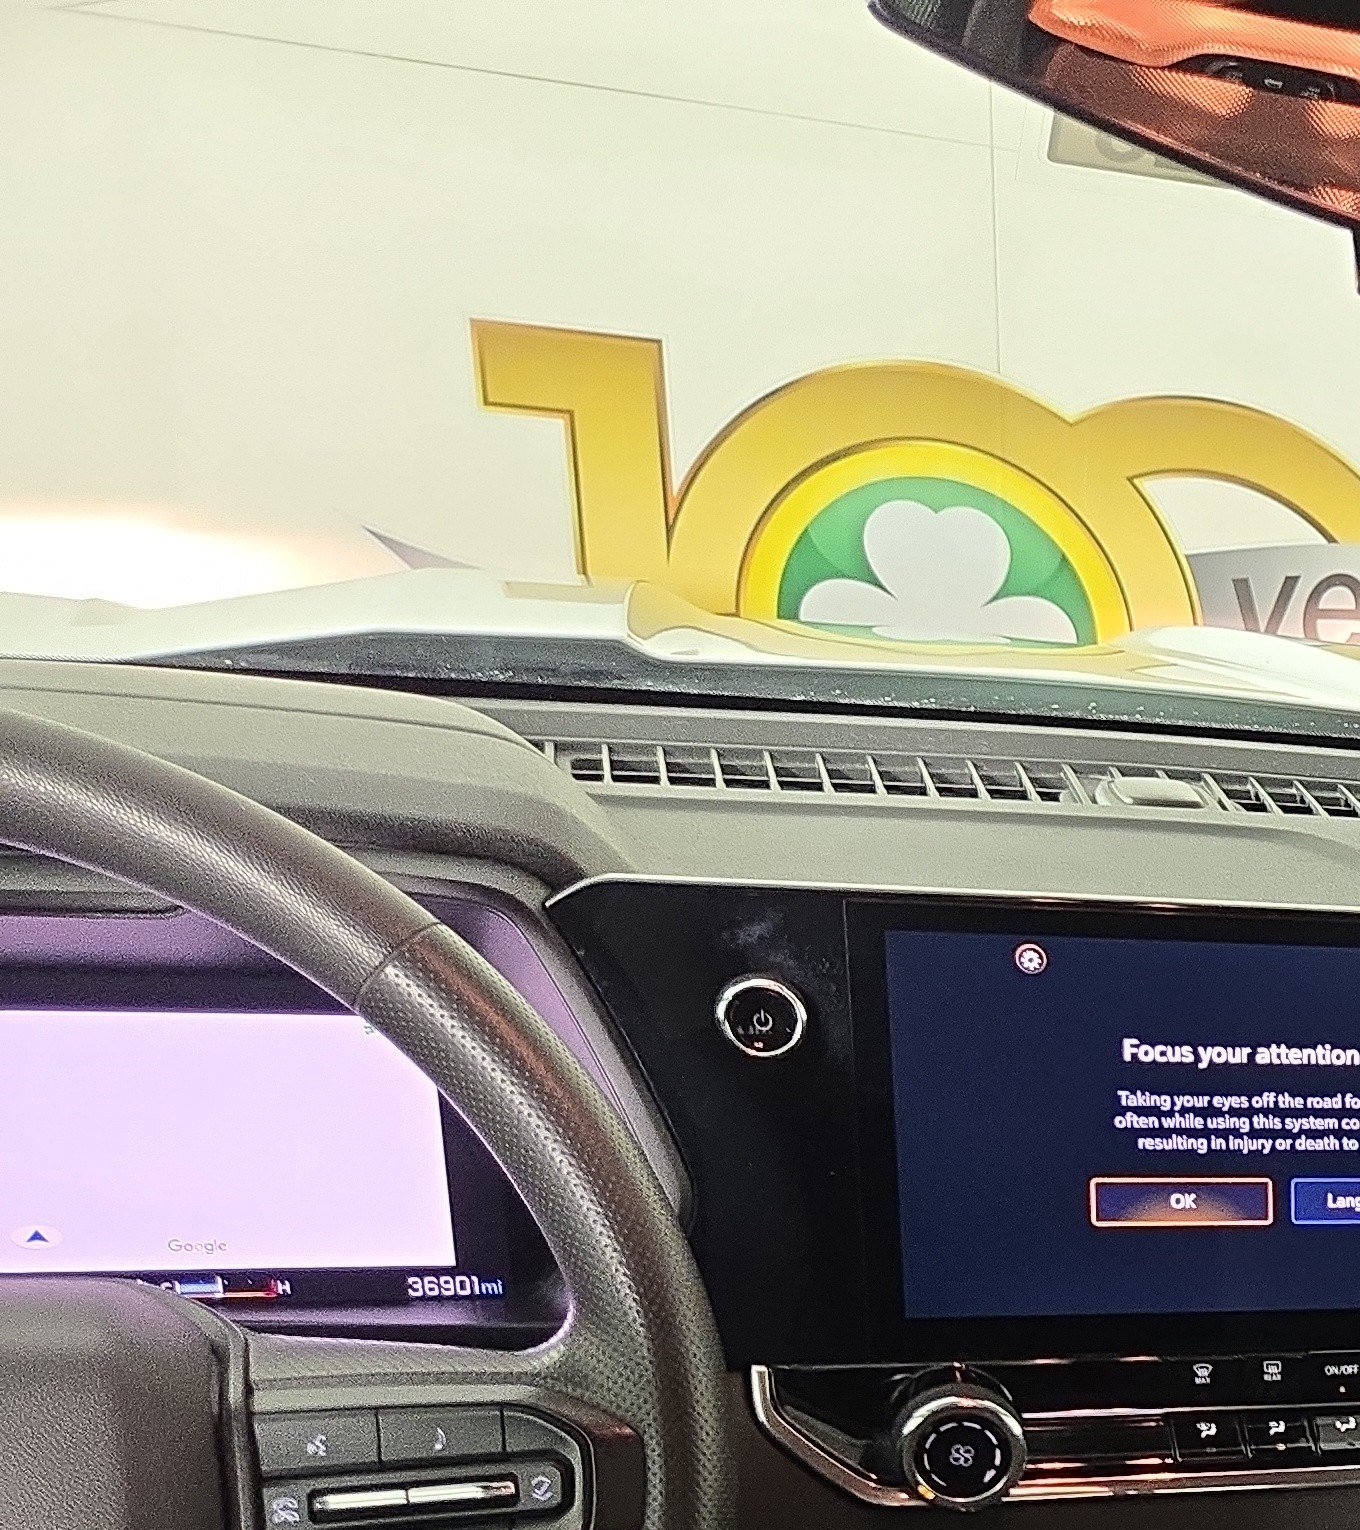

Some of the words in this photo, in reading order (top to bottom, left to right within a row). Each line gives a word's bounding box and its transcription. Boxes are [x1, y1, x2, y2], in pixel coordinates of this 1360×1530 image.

[1122, 1037, 1194, 1064] Focus
[1197, 1045, 1252, 1069] your
[1255, 1043, 1360, 1067] attention
[1117, 1091, 1171, 1111] Taking
[1173, 1095, 1210, 1111] your
[1212, 1095, 1249, 1111] eyes
[1251, 1093, 1276, 1109] off
[1277, 1093, 1304, 1109] the
[1306, 1094, 1342, 1109] road
[1114, 1113, 1159, 1130] often
[1161, 1114, 1204, 1130] while
[1206, 1114, 1250, 1133] using
[1252, 1114, 1282, 1131] this
[1284, 1116, 1339, 1134] system
[1137, 1135, 1208, 1154] resulting
[1210, 1135, 1226, 1151] in
[1228, 1135, 1273, 1155] injury
[1275, 1138, 1294, 1151] or
[1295, 1135, 1340, 1152] death
[1341, 1136, 1358, 1151] to
[1170, 1192, 1197, 1210] OK
[167, 1238, 228, 1256] Google
[1324, 1363, 1360, 1376] ON/OFF
